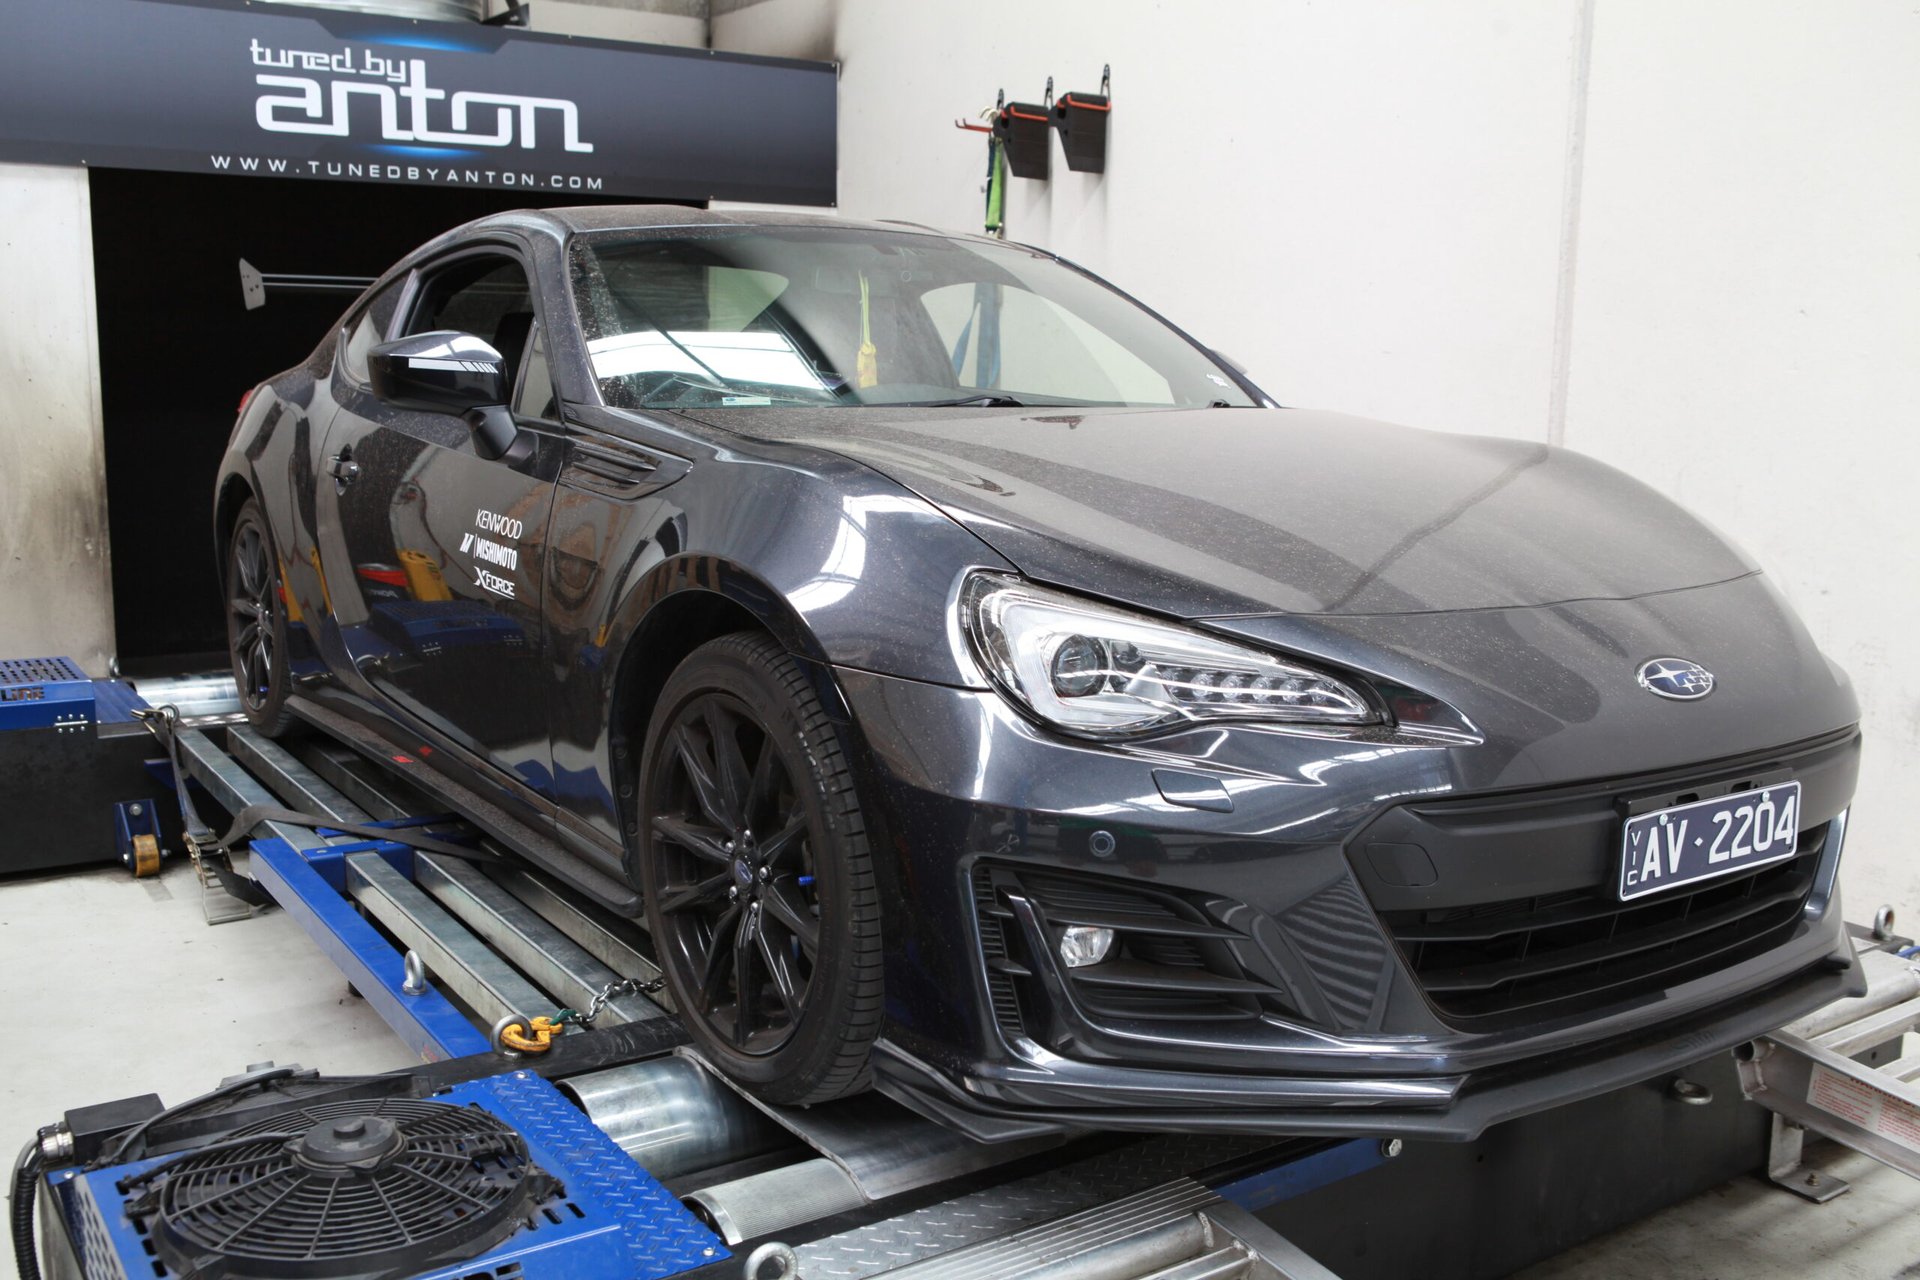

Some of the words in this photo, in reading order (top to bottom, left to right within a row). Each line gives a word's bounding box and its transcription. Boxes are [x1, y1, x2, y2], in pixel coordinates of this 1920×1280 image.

[250, 39, 356, 74] tuned
[360, 50, 406, 83] by
[255, 60, 594, 153] anton
[211, 155, 602, 190] WWW.TUNEDBYANTON.COM
[475, 509, 523, 540] KENWOOD
[476, 537, 518, 571] MISHIMOTO
